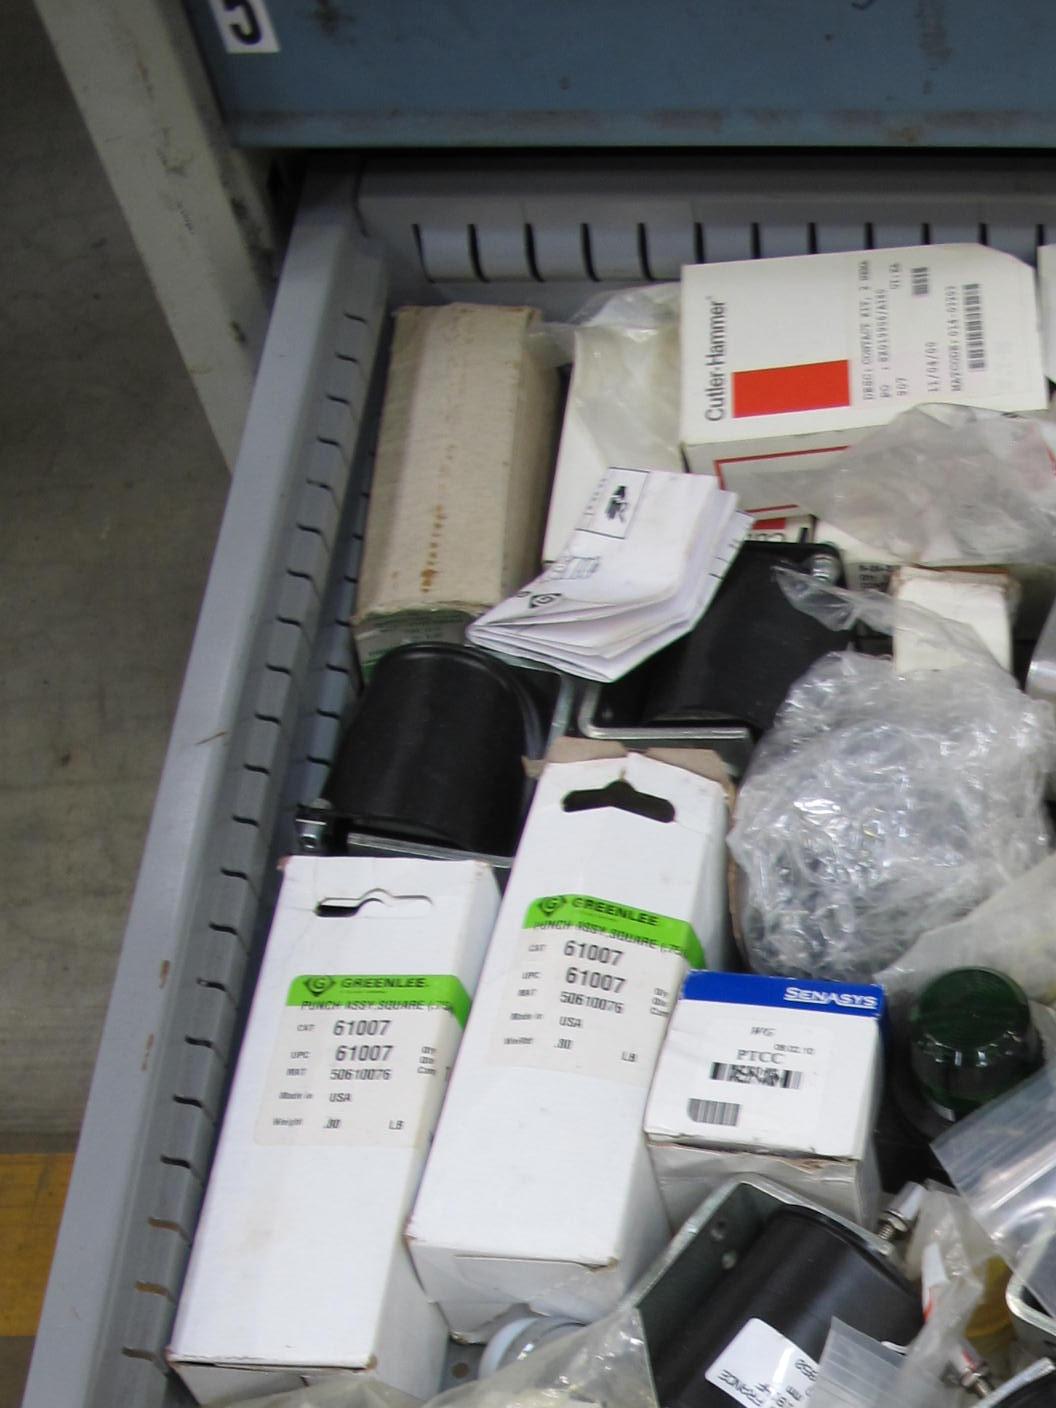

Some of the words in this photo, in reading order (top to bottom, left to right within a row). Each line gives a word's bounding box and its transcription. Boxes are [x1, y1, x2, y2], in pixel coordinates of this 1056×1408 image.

[704, 296, 727, 421] Cutler-Hammer
[572, 898, 660, 926] GREENLEE
[564, 940, 624, 966] 61007
[341, 977, 426, 989] GREENLEE
[566, 967, 626, 993] 61007
[301, 1000, 341, 1011] PUNCH
[560, 991, 625, 1014] 50610076
[784, 987, 879, 1010] SENASYS
[333, 1020, 392, 1036] 61007
[559, 1016, 583, 1029] USA
[335, 1045, 394, 1061] 61007
[737, 1049, 784, 1065] PTCC
[330, 1069, 392, 1081] 50610076
[329, 1093, 352, 1103] USA
